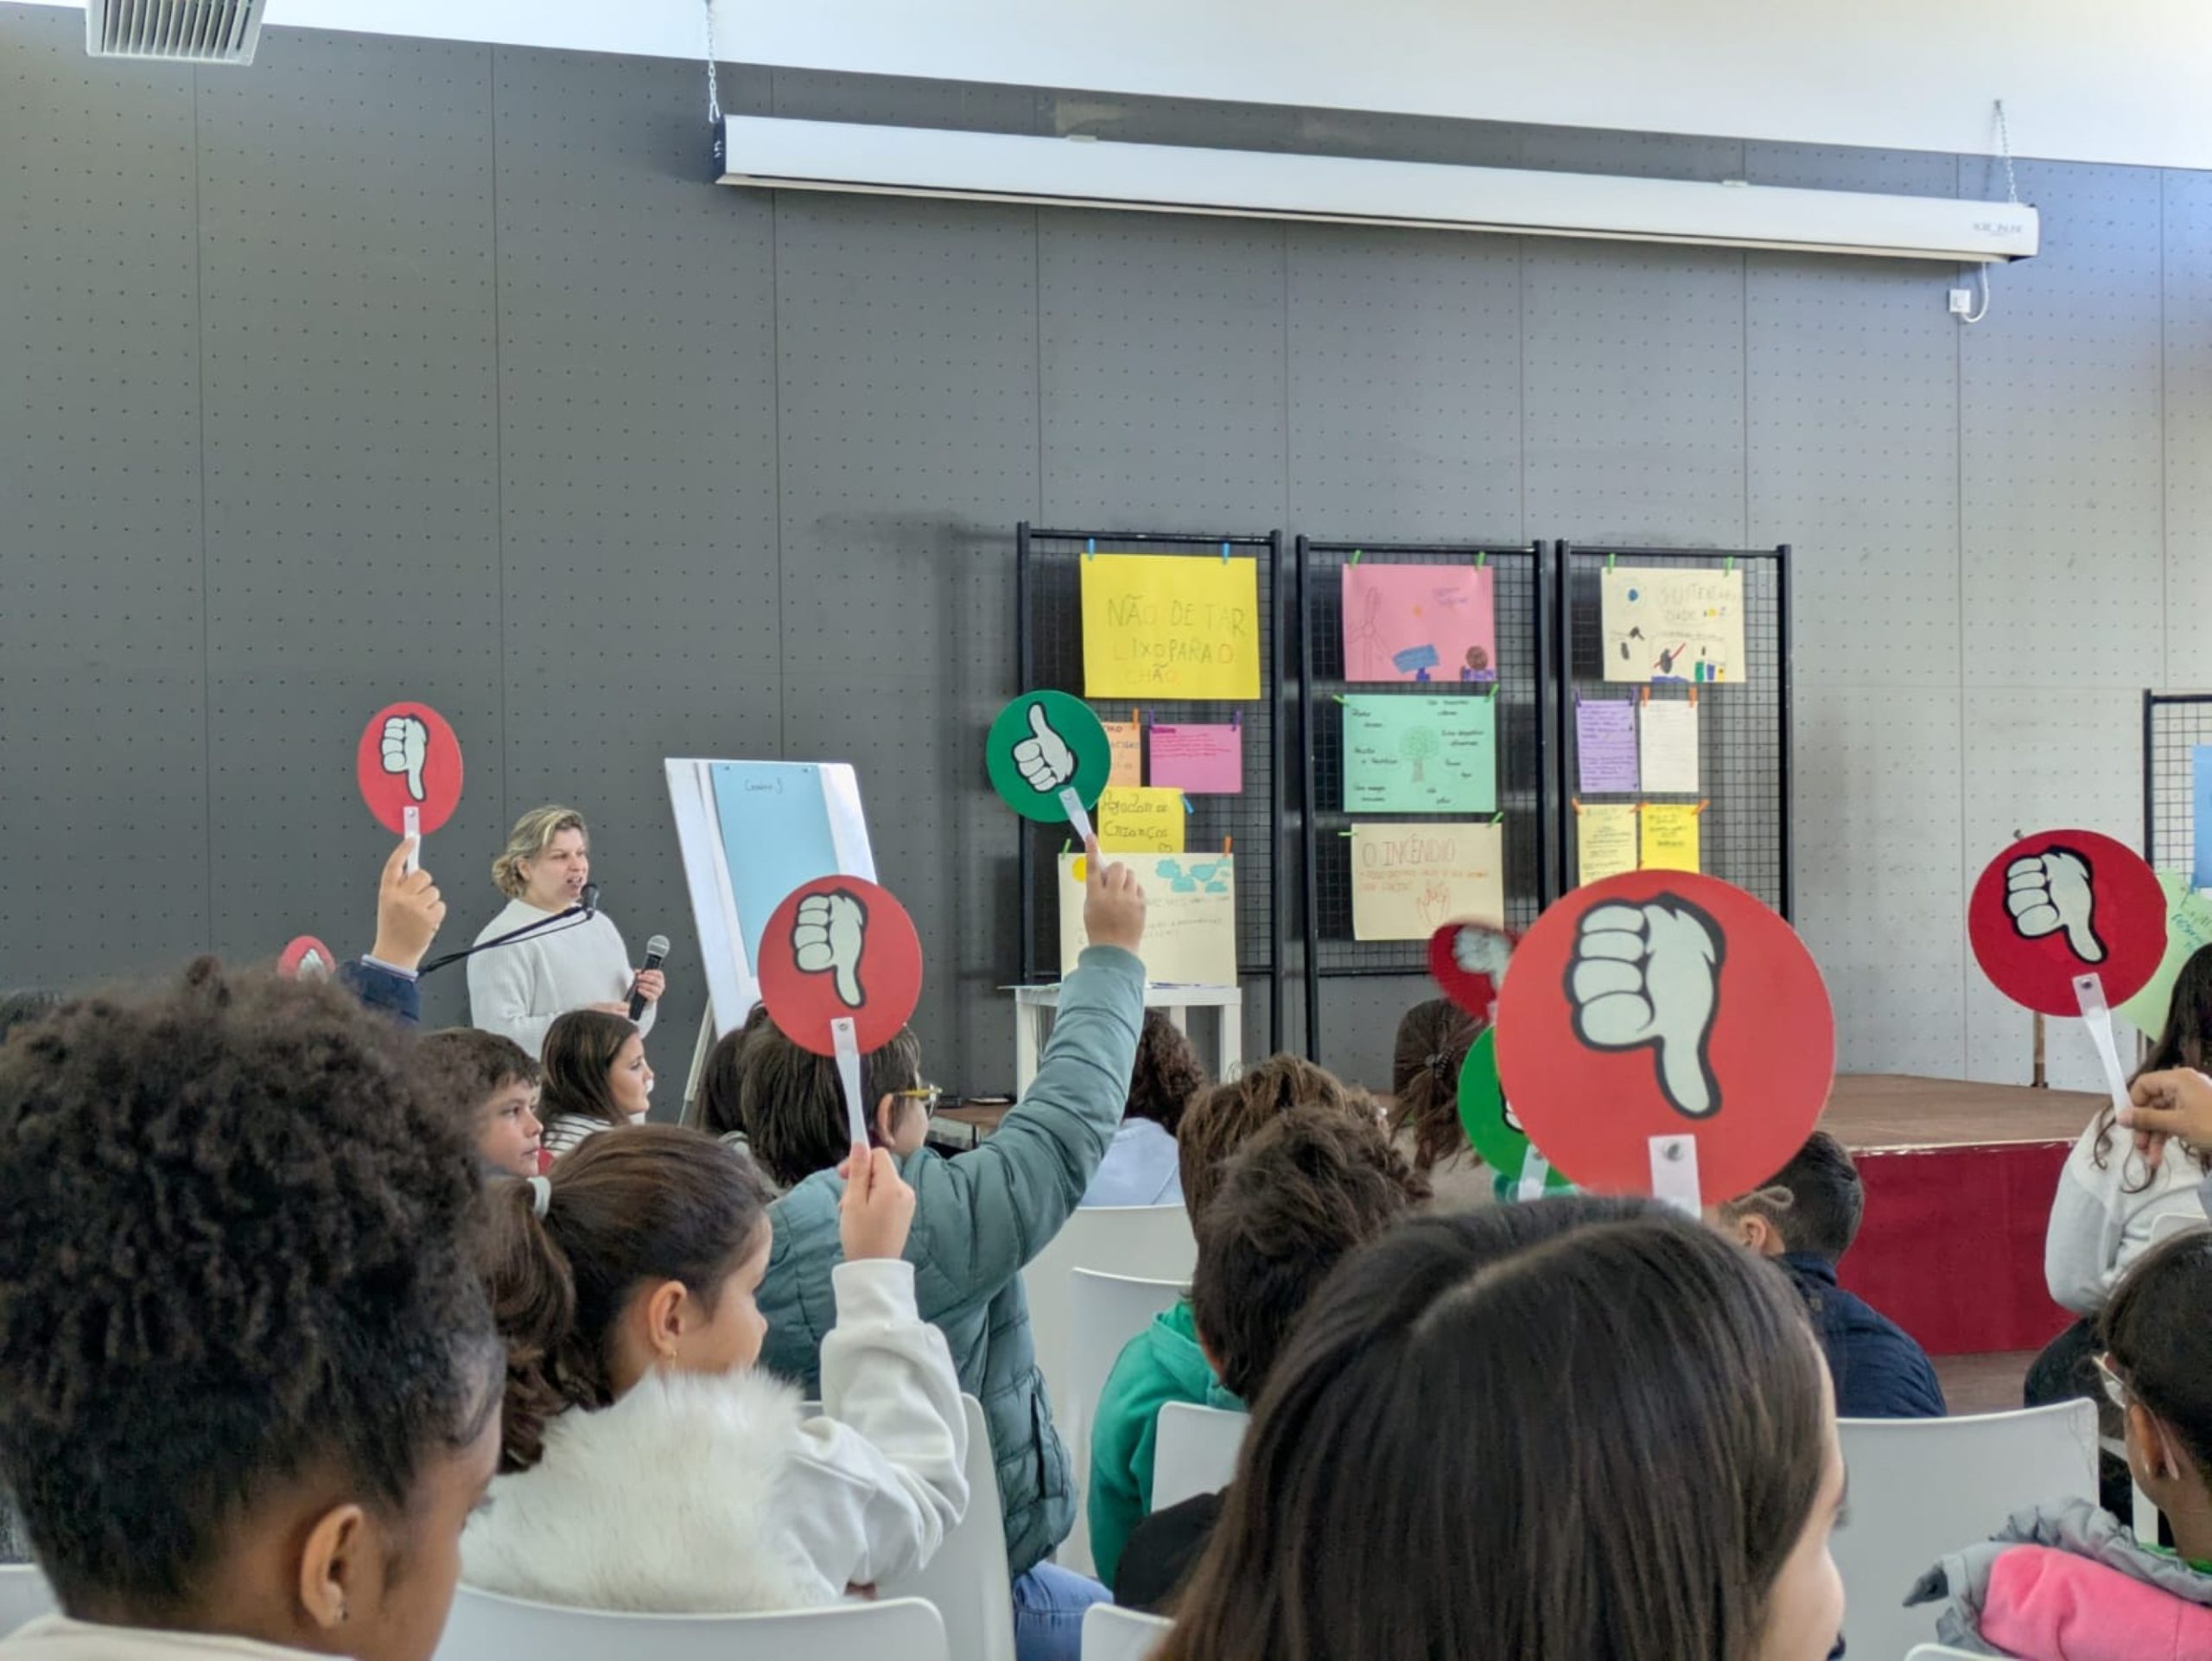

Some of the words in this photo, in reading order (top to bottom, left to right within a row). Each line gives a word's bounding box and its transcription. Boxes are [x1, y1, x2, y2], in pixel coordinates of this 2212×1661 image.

[1108, 594, 1157, 627] NÃO
[1113, 637, 1166, 661] LIXO
[1362, 842, 1377, 868] O
